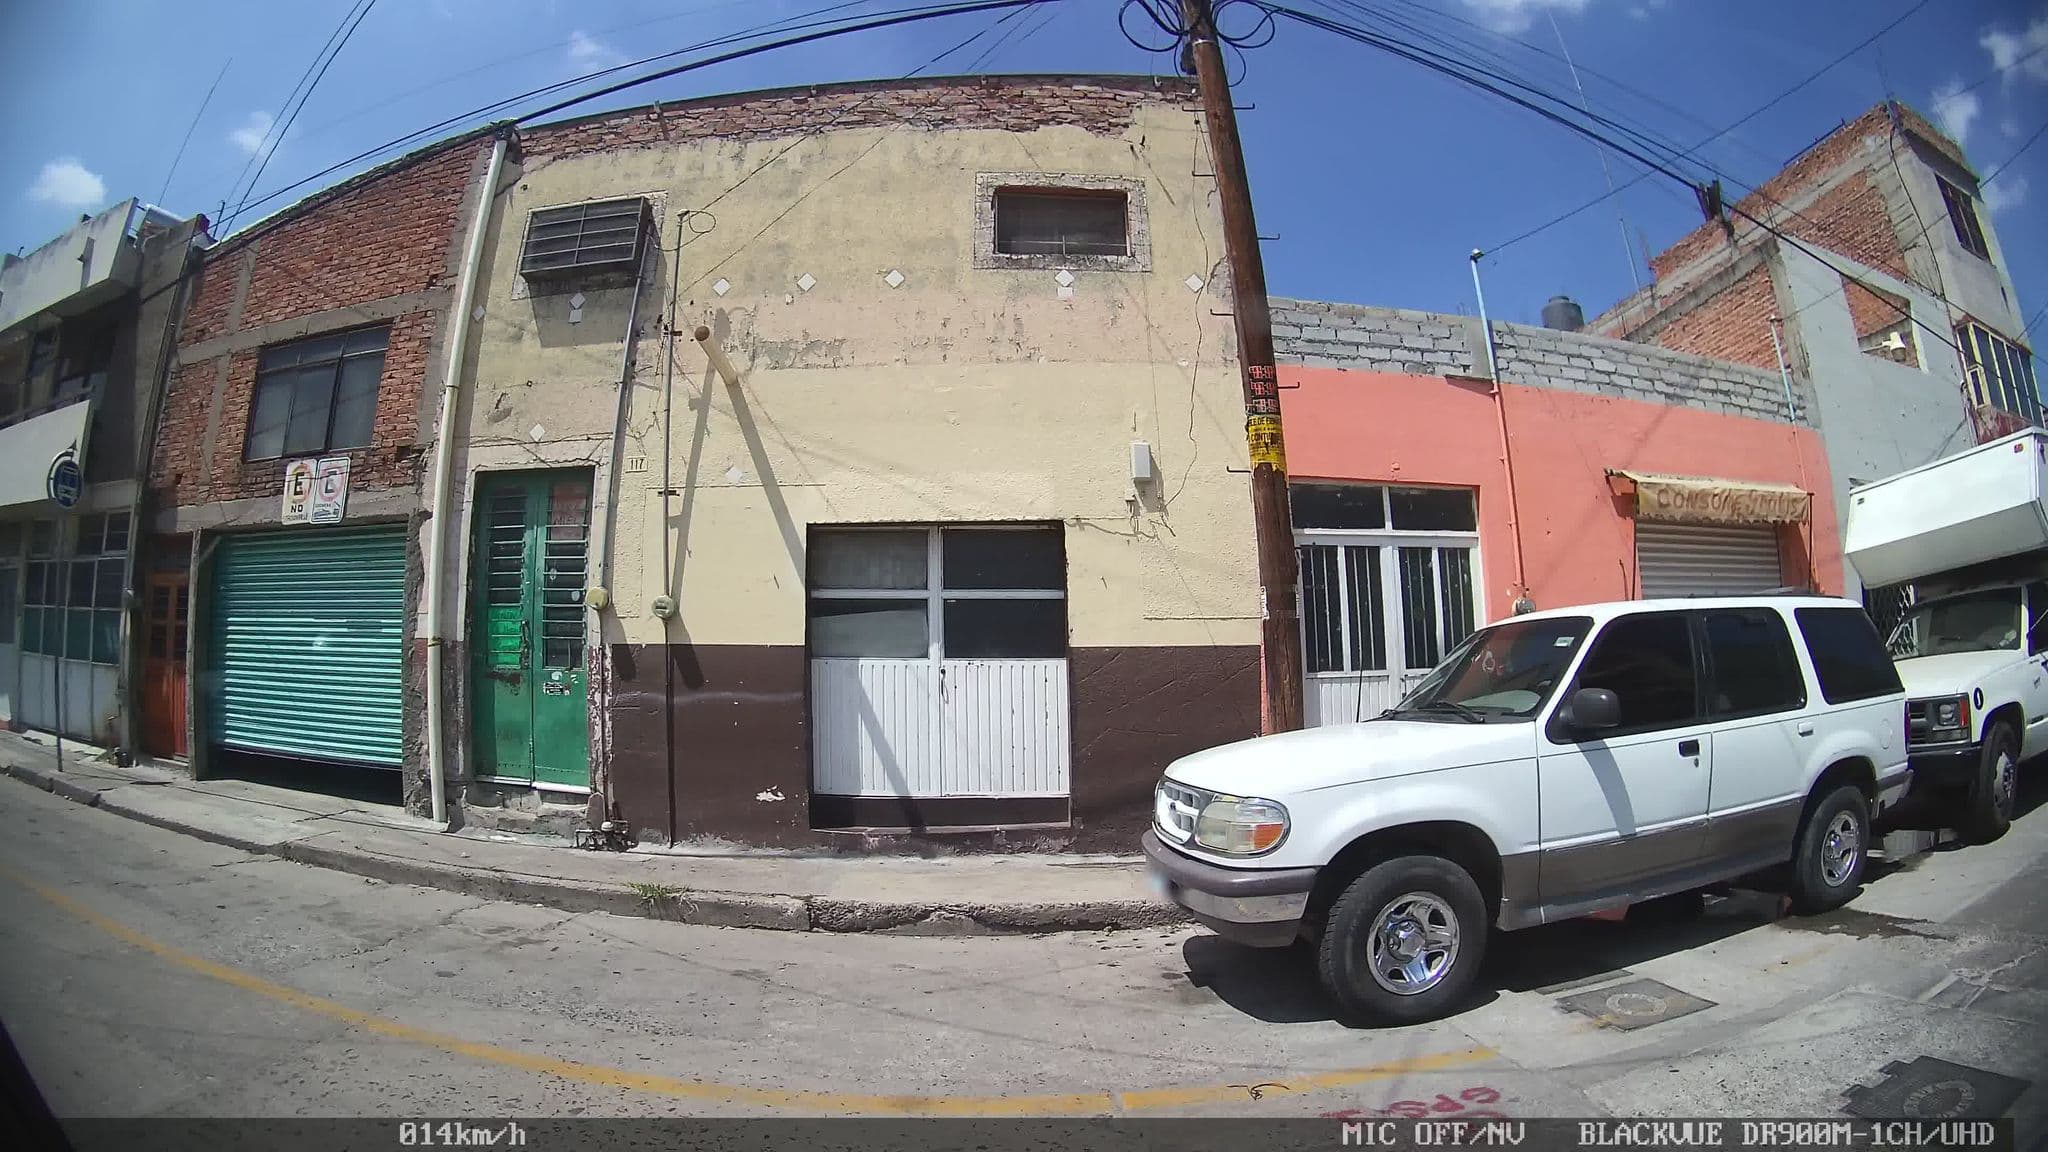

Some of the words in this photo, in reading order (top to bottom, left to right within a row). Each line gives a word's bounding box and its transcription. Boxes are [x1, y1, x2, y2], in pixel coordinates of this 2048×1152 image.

[630, 458, 645, 470] 117
[294, 471, 305, 496] E
[290, 504, 304, 514] NO
